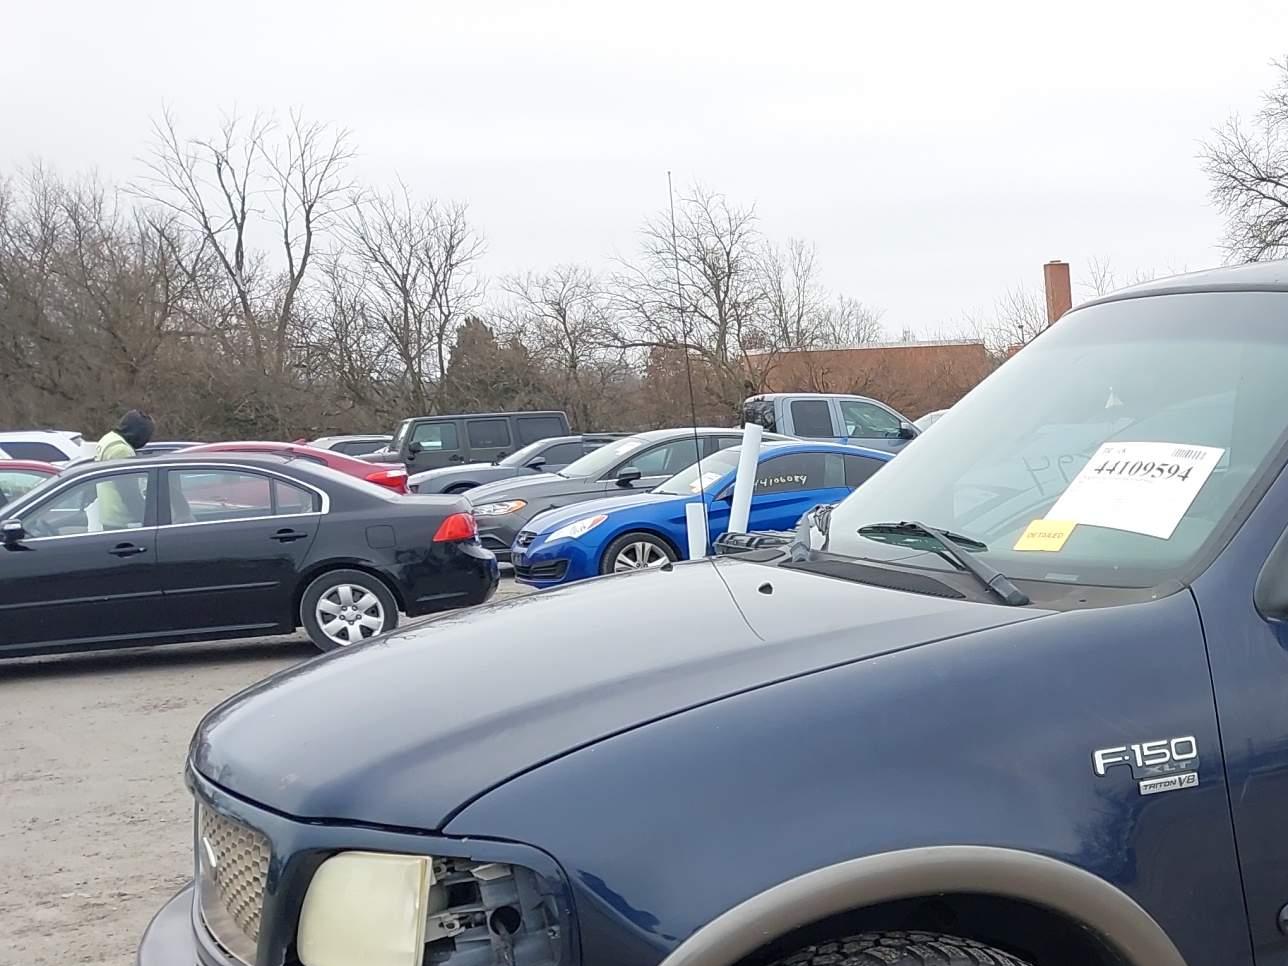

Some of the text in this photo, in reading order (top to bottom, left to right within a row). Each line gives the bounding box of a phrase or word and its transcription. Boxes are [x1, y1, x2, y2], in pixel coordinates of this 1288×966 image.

[1094, 460, 1194, 482] 44109594
[1144, 760, 1193, 774] XLT
[1143, 774, 1196, 791] TRITON V8
